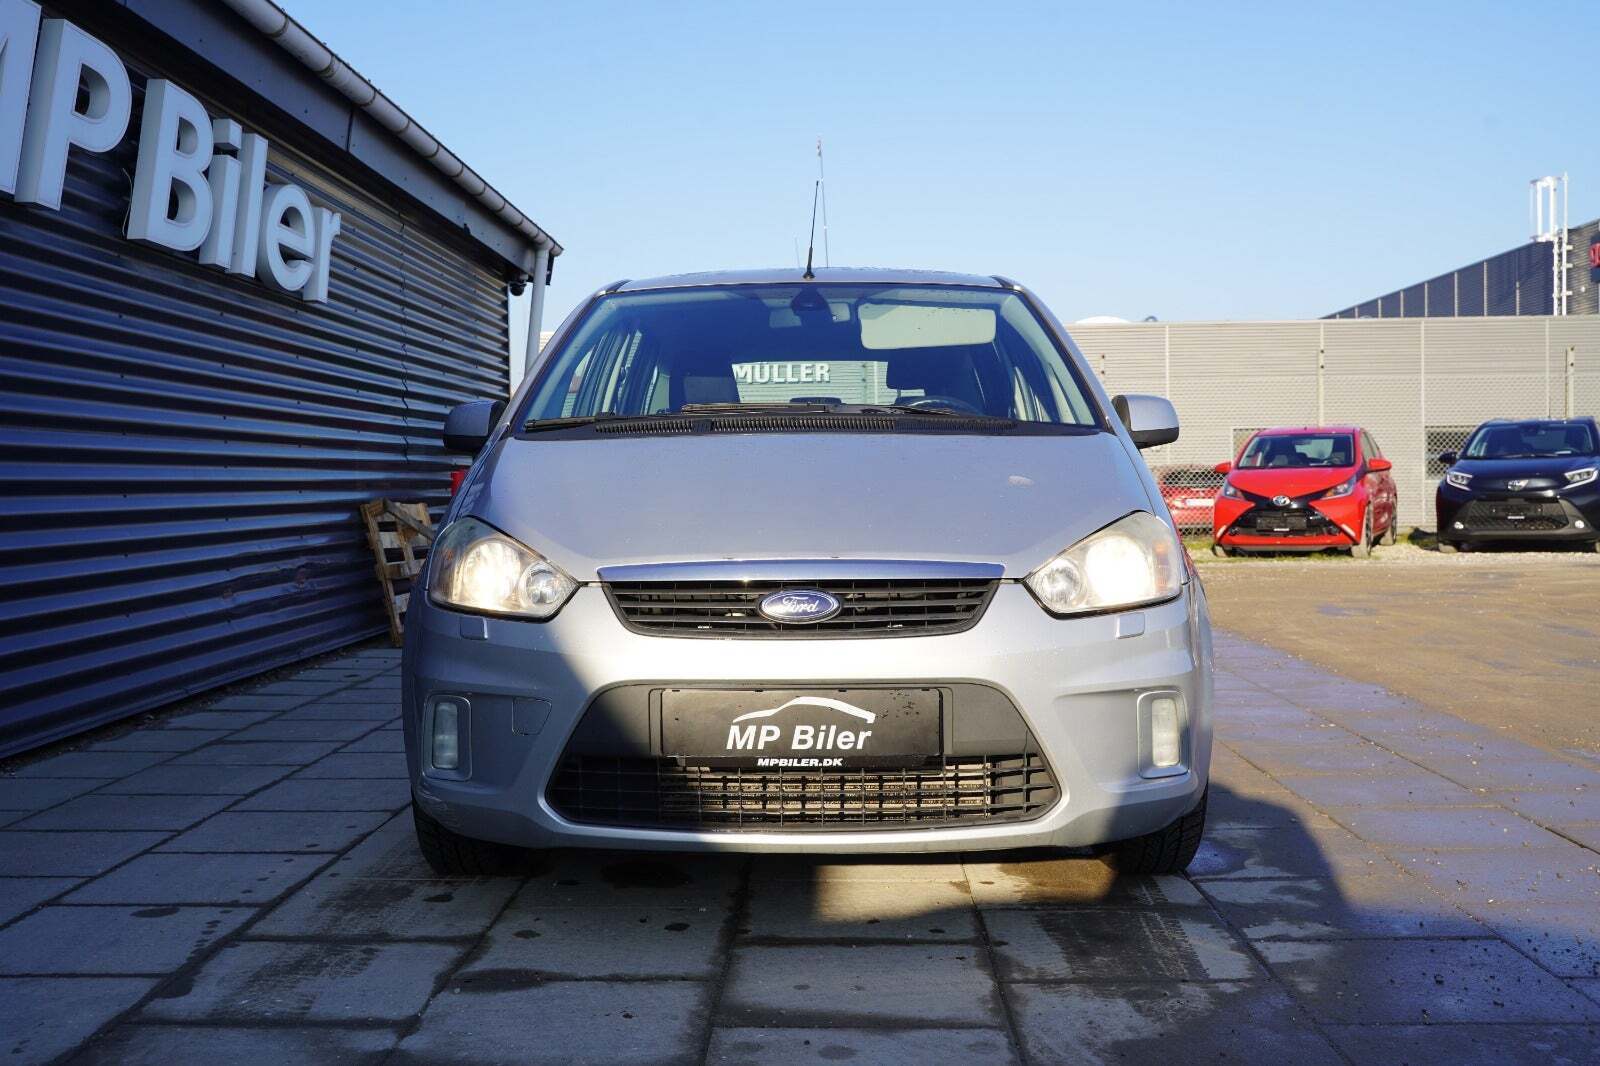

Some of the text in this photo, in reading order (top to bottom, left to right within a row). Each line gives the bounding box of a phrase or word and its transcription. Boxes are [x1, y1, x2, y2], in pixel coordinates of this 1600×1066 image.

[127, 78, 341, 303] Biler
[782, 596, 820, 613] Ford
[726, 725, 872, 750] MP Biler
[757, 758, 843, 767] MPBILER.DK
